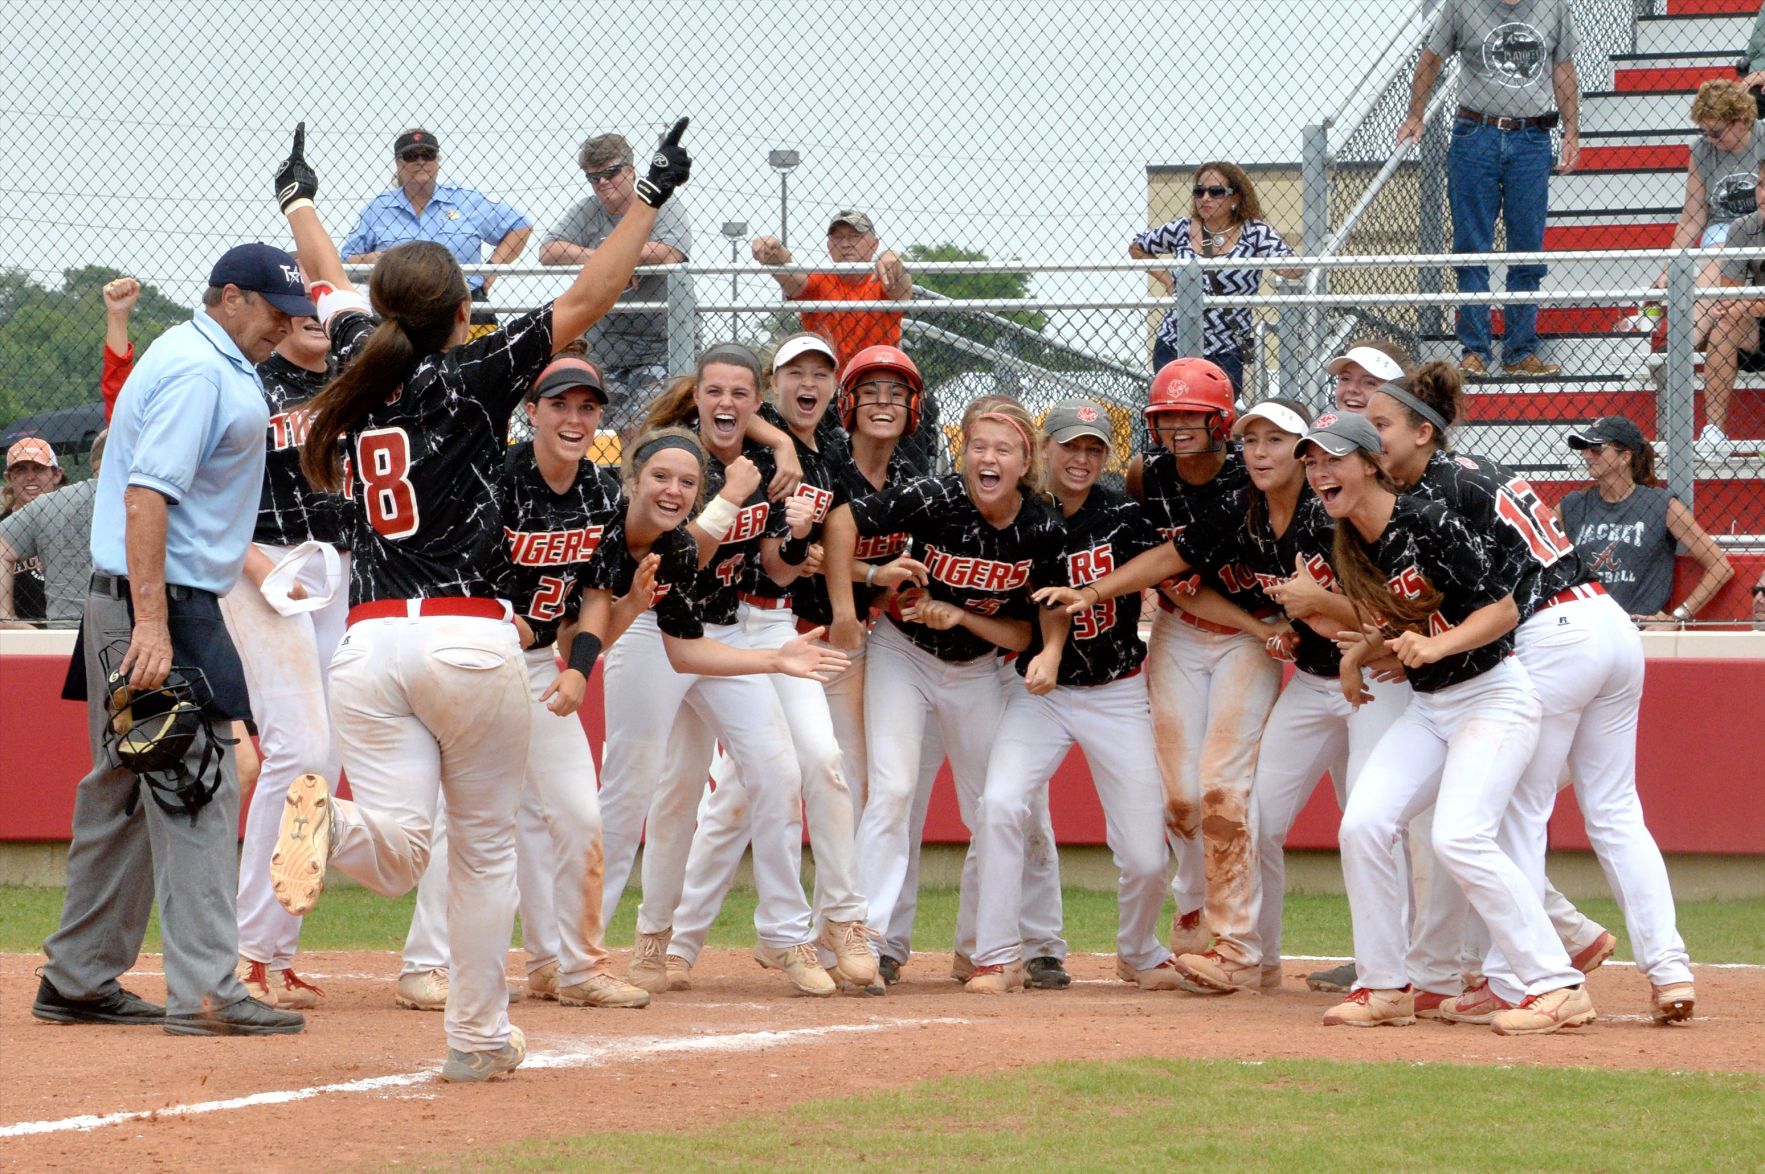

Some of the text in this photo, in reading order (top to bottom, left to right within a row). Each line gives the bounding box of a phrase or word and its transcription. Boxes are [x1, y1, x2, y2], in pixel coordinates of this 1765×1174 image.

[356, 426, 420, 541] 8
[503, 525, 605, 567] TIGERS
[720, 501, 770, 545] ER
[1495, 477, 1574, 568] 12
[924, 543, 1033, 592] TIGERS
